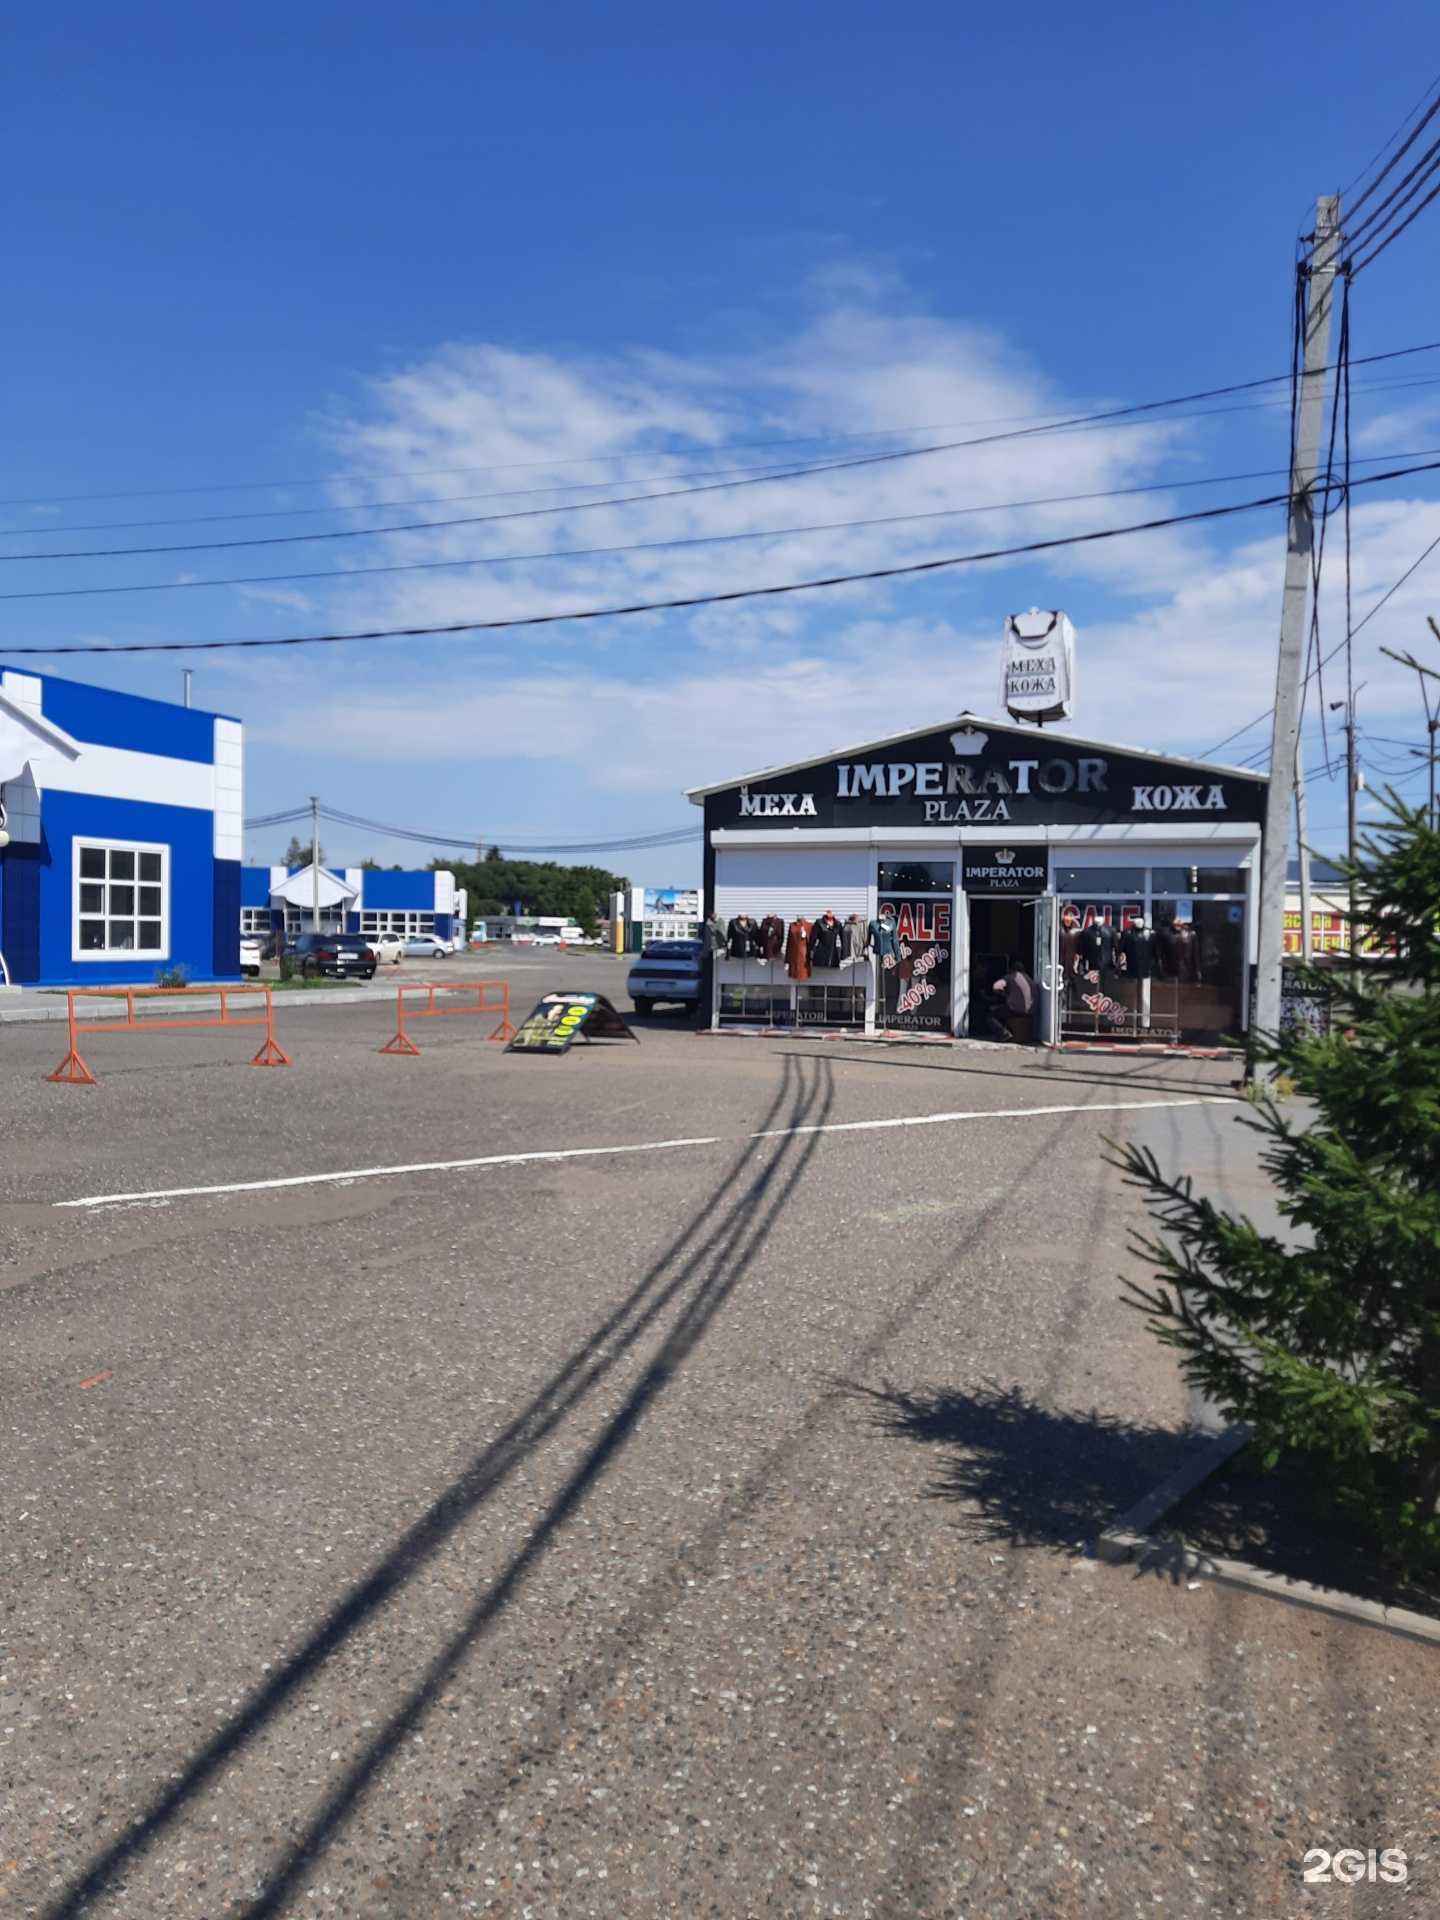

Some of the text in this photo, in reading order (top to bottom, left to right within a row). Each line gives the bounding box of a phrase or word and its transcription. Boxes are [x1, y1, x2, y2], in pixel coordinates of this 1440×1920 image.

[1010, 657, 1056, 674] МЕХА
[1010, 677, 1056, 693] КОЖА
[837, 758, 1108, 798] IMPERATOR
[738, 792, 818, 816] МЕХА
[1131, 784, 1228, 811] КОЖА
[923, 799, 1012, 822] PLAZA
[965, 866, 1044, 878] IMPERATOR
[990, 878, 1020, 888] PLAZA
[896, 978, 937, 1013] -40%
